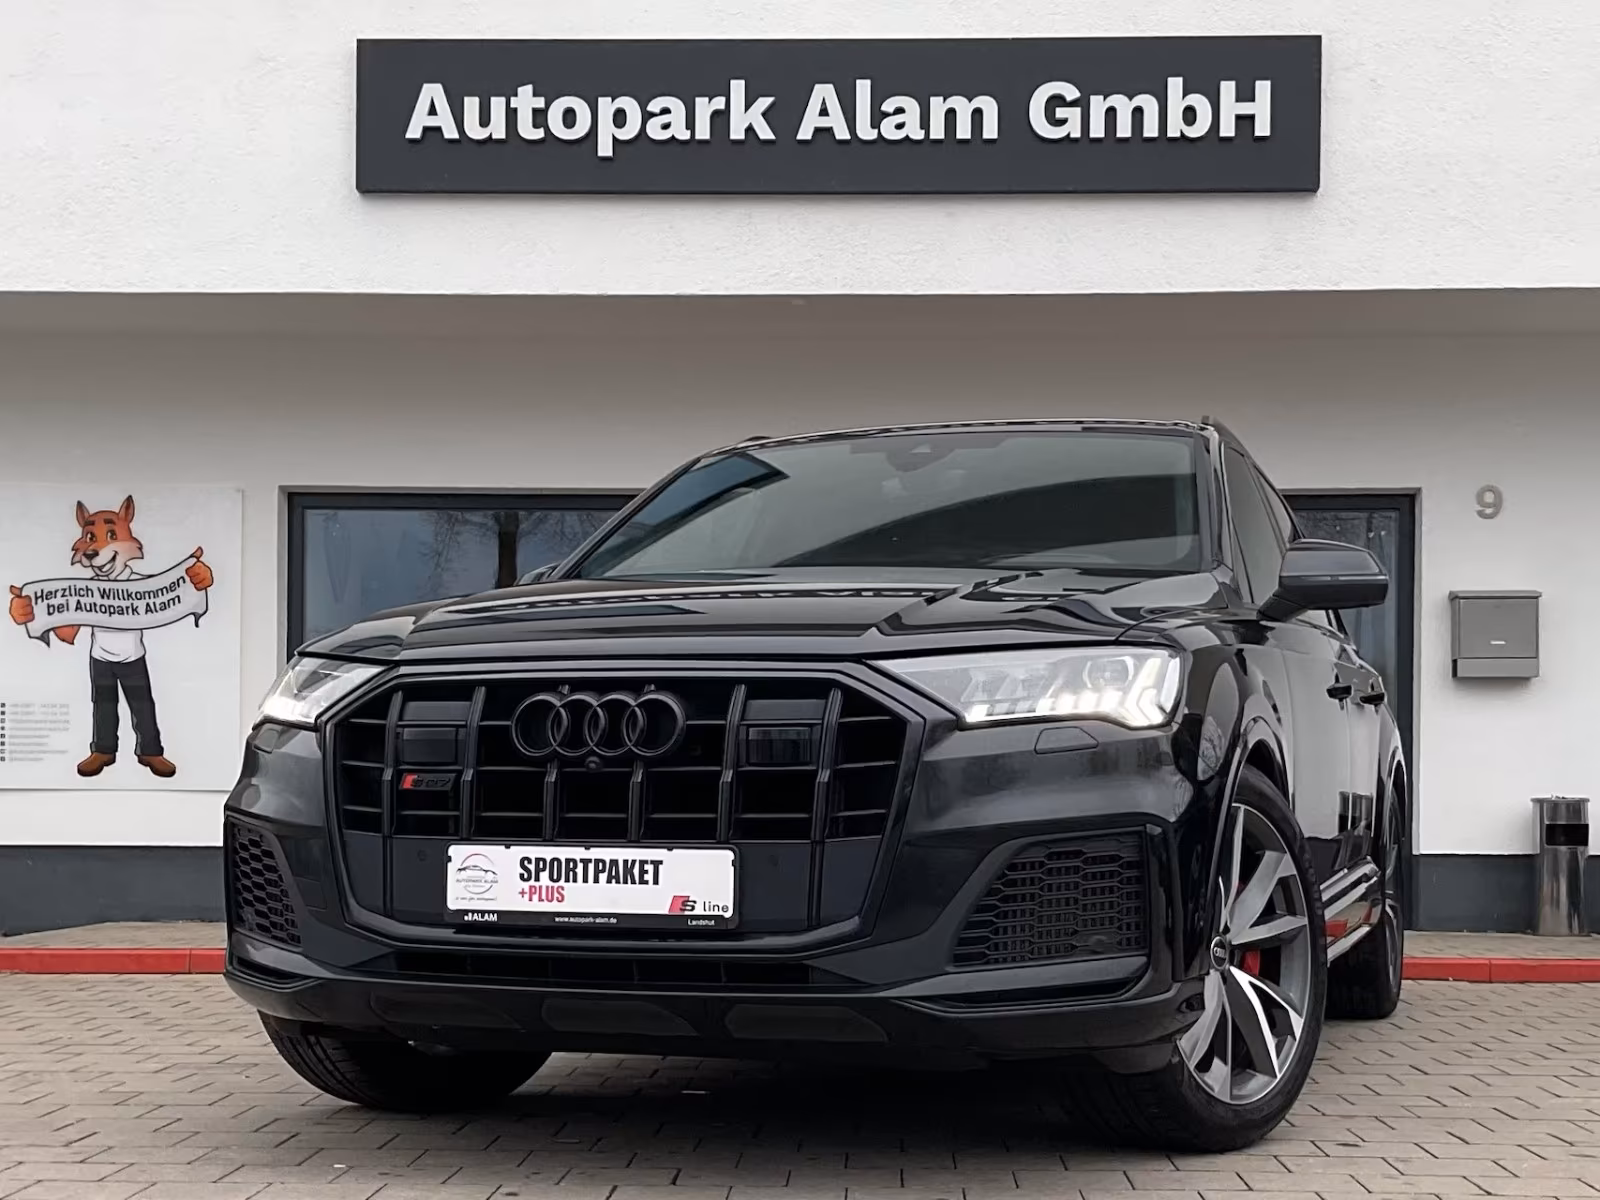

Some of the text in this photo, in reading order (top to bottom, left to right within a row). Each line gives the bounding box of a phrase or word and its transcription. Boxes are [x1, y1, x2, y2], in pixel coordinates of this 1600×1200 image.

[404, 75, 1273, 158] Autopark Alam GmbH
[1475, 484, 1503, 519] 9
[34, 575, 187, 605] Herzlich Willkommen
[46, 594, 182, 618] bei Autopark Alam
[518, 856, 664, 886] SPORTPAKET
[518, 885, 566, 903] +PLUS
[703, 901, 729, 913] line
